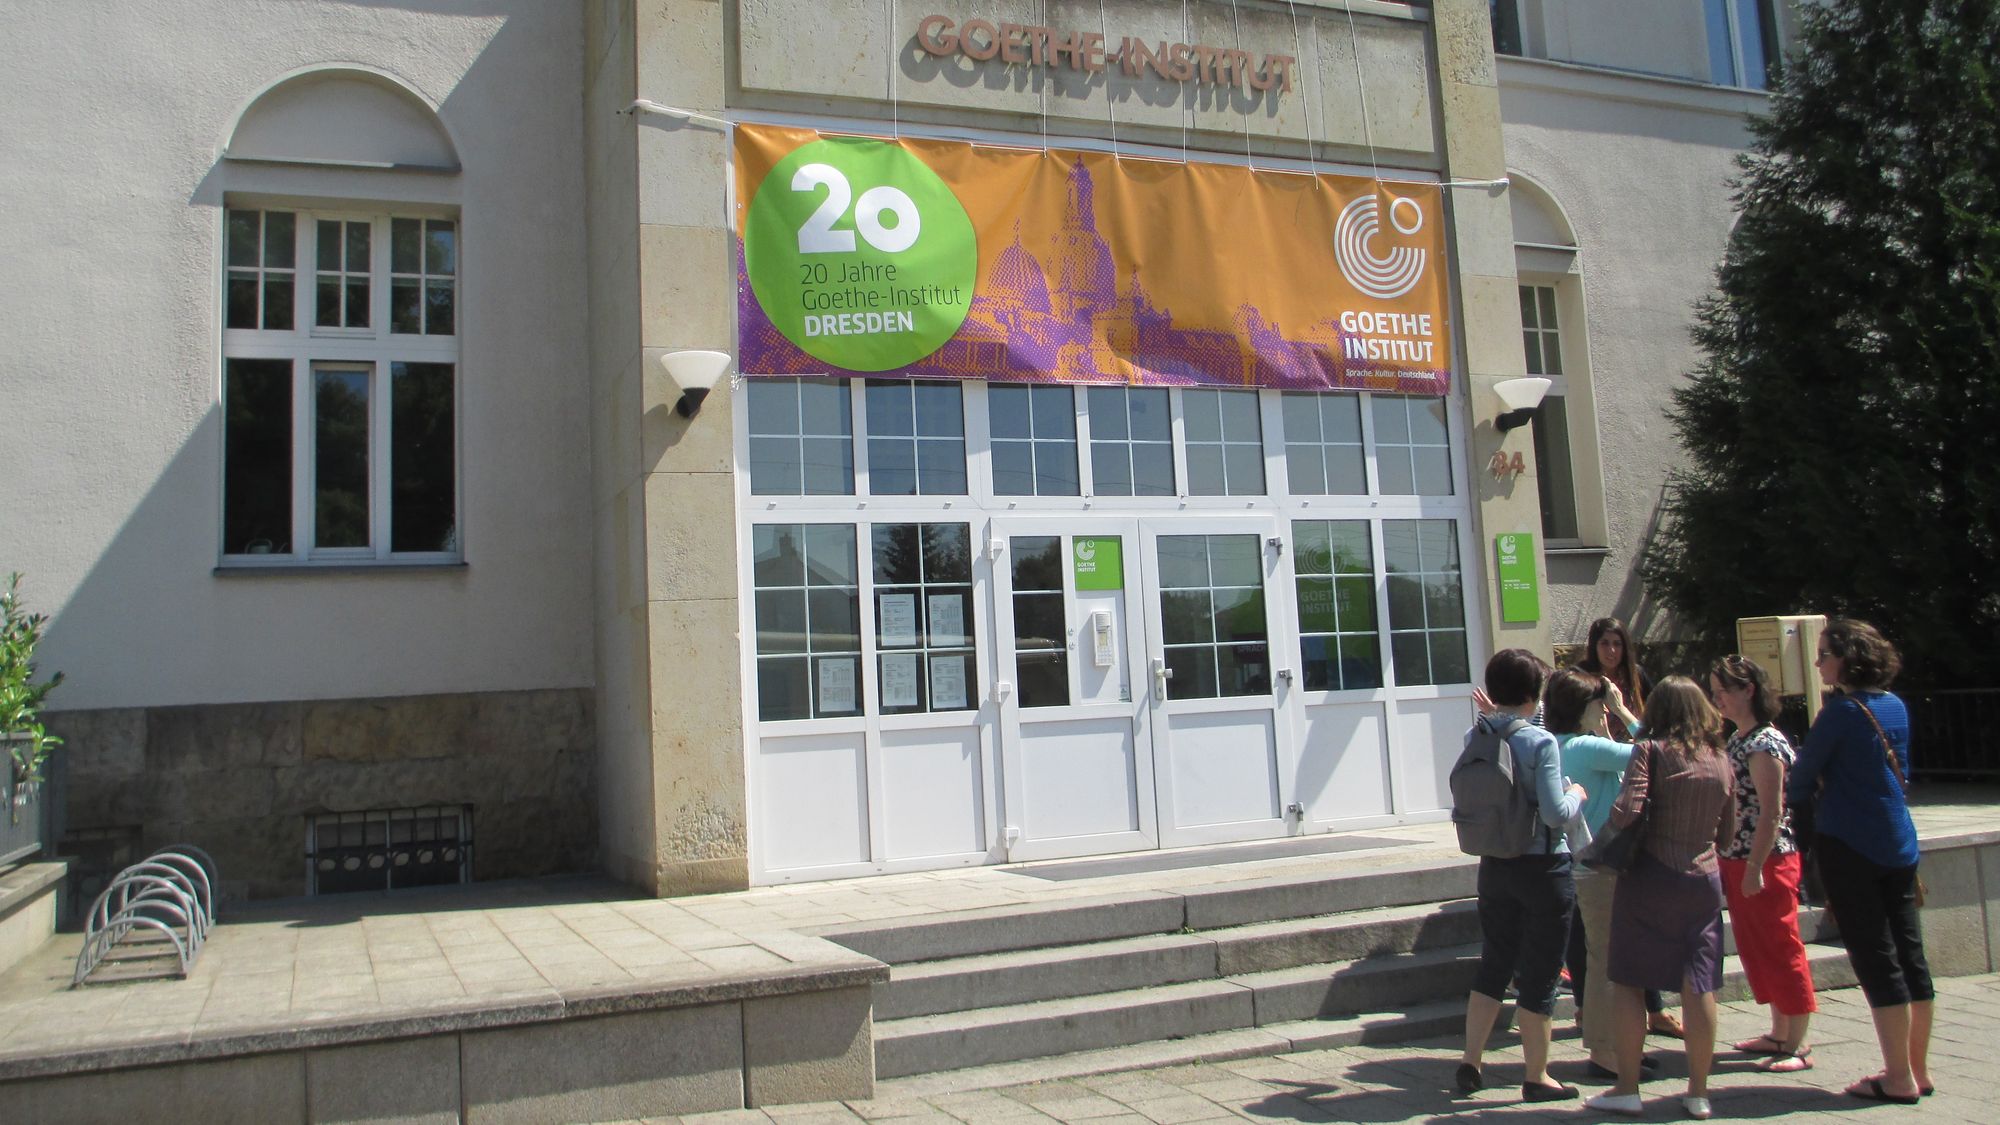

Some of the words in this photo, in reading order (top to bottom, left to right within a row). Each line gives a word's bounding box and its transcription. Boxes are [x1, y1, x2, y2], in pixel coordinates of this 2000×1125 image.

[916, 14, 1295, 93] GOETHE-INSTITUT
[791, 163, 921, 254] 20
[800, 263, 828, 285] 20
[837, 261, 897, 283] Jahre
[802, 284, 962, 311] Goethe-Institut
[804, 310, 914, 337] DRESDEN
[1340, 311, 1433, 336] GOETHE
[1344, 337, 1433, 362] INSTITUT
